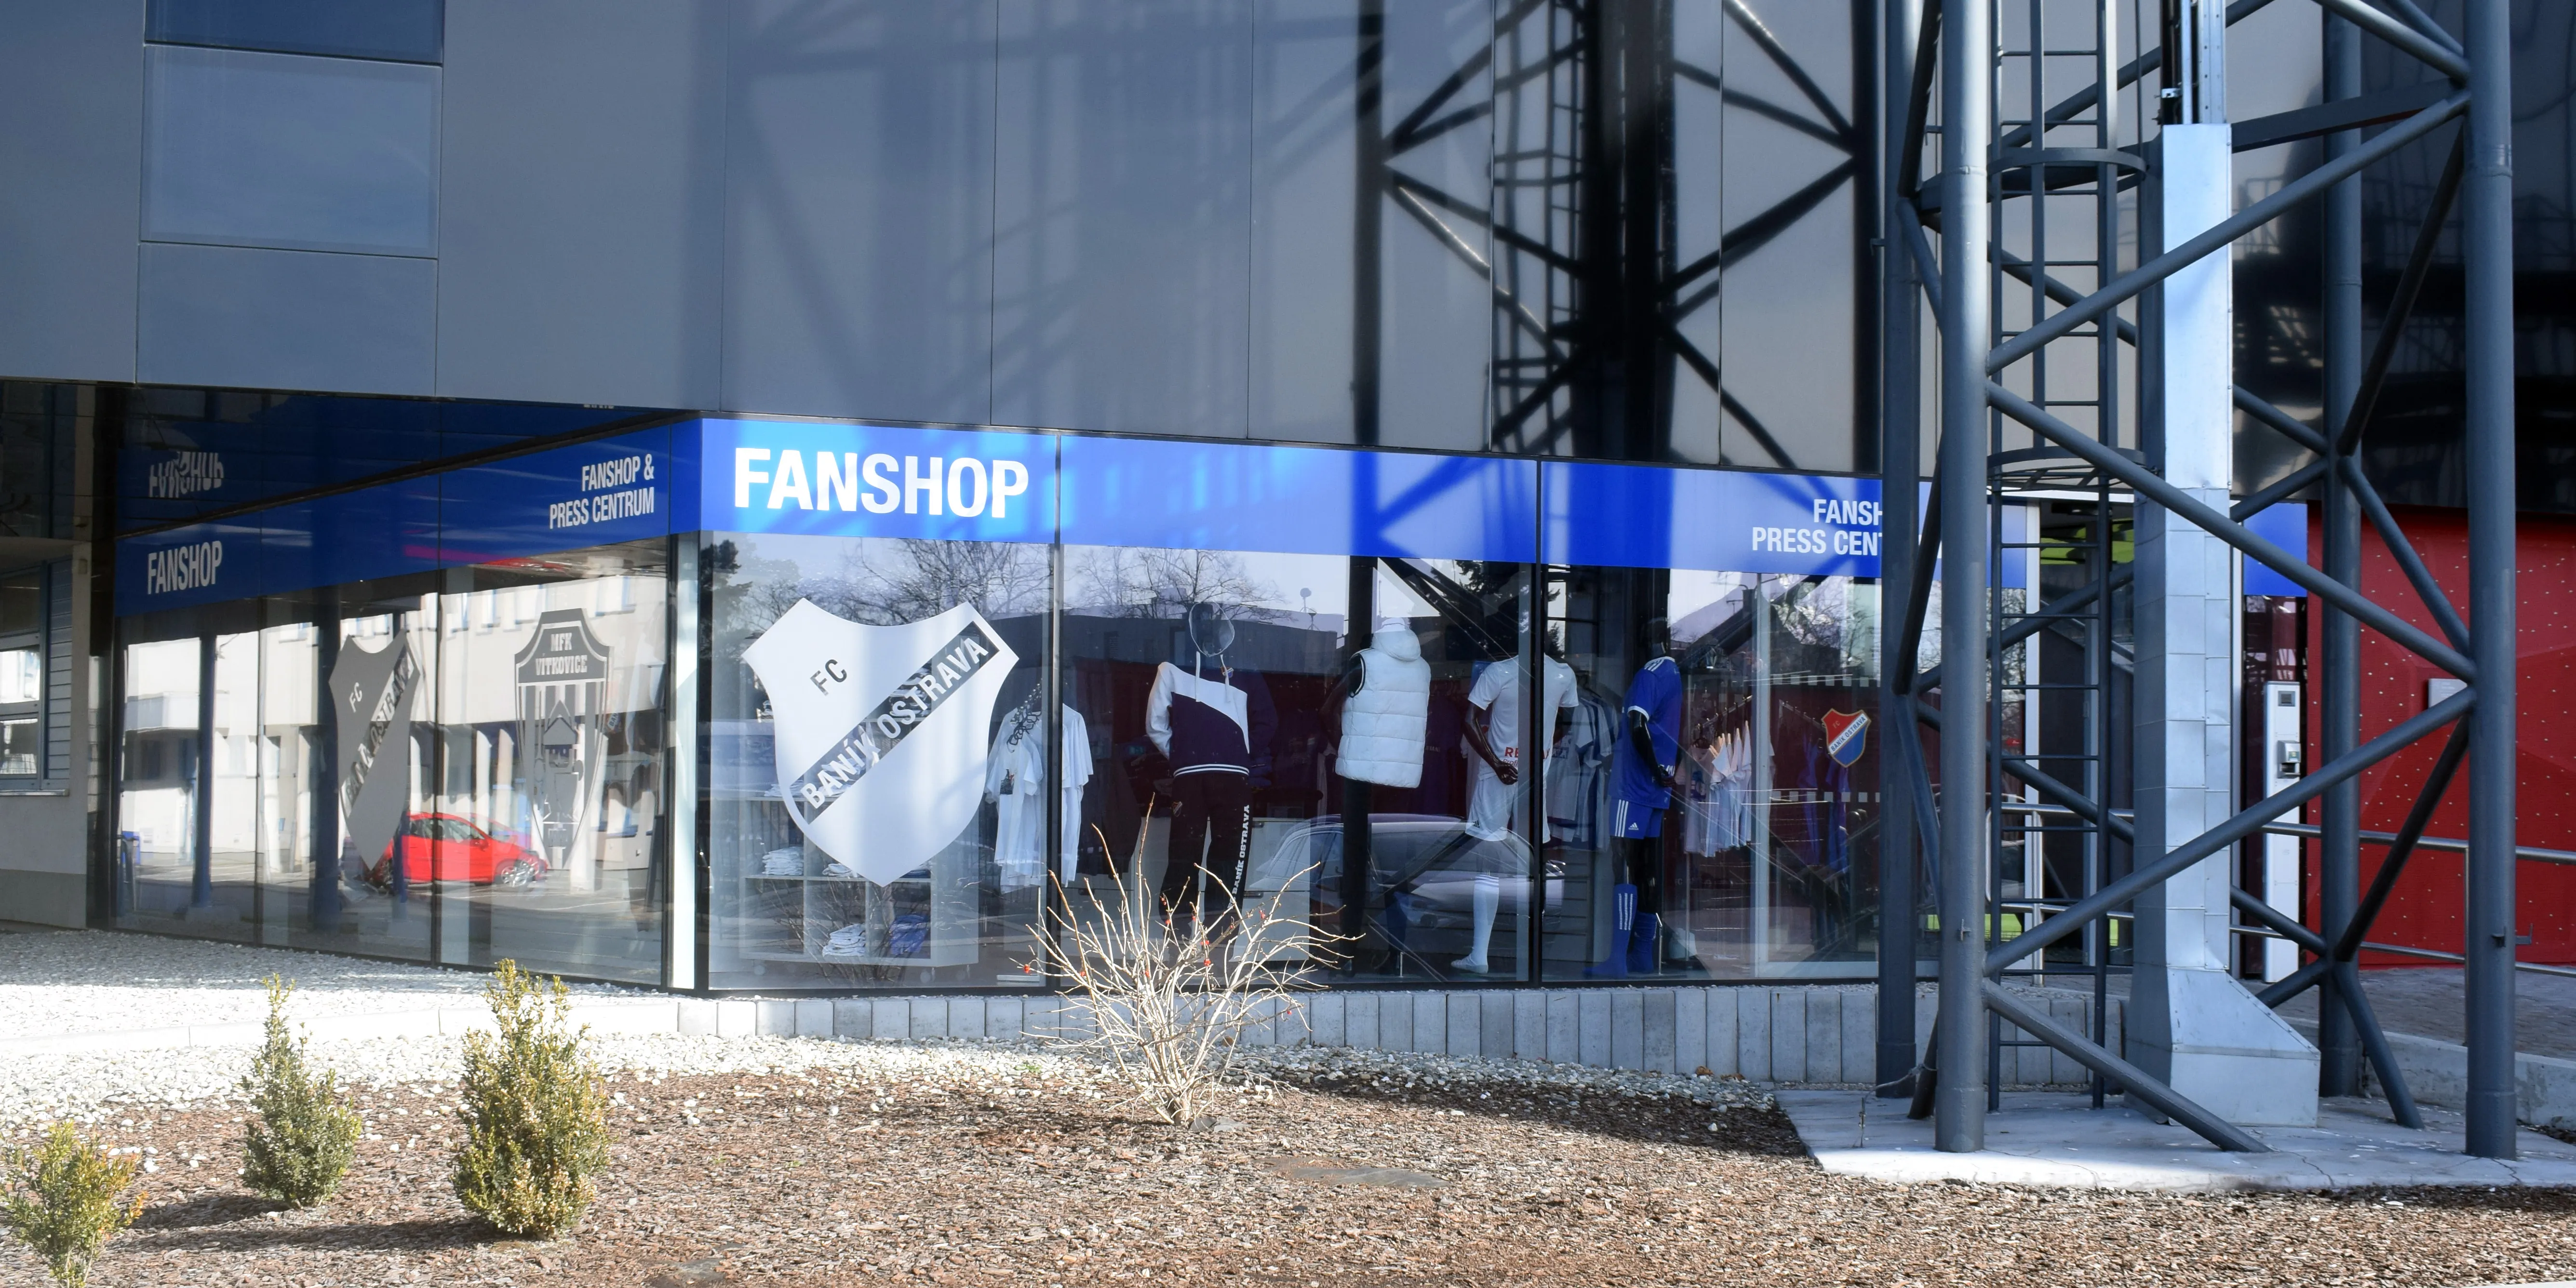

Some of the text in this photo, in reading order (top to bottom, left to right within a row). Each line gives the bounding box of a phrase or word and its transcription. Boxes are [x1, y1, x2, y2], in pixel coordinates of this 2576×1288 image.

[582, 454, 654, 492] FANSHOP &
[735, 447, 1029, 518] FANSHOP
[550, 487, 654, 529] PRESS CENTRUM
[1813, 499, 1882, 526] FANSH
[1752, 527, 1882, 556] PRESS CEN
[148, 540, 222, 594] FANSHOP
[551, 632, 572, 651] MFK
[810, 659, 847, 696] FC
[349, 682, 362, 712] FC
[800, 637, 989, 809] BANÍK OSTRAVA
[1845, 717, 1865, 738] OSTRAVA
[1232, 860, 1244, 895] BANÍK
[1240, 805, 1249, 858] OSTRAVA
